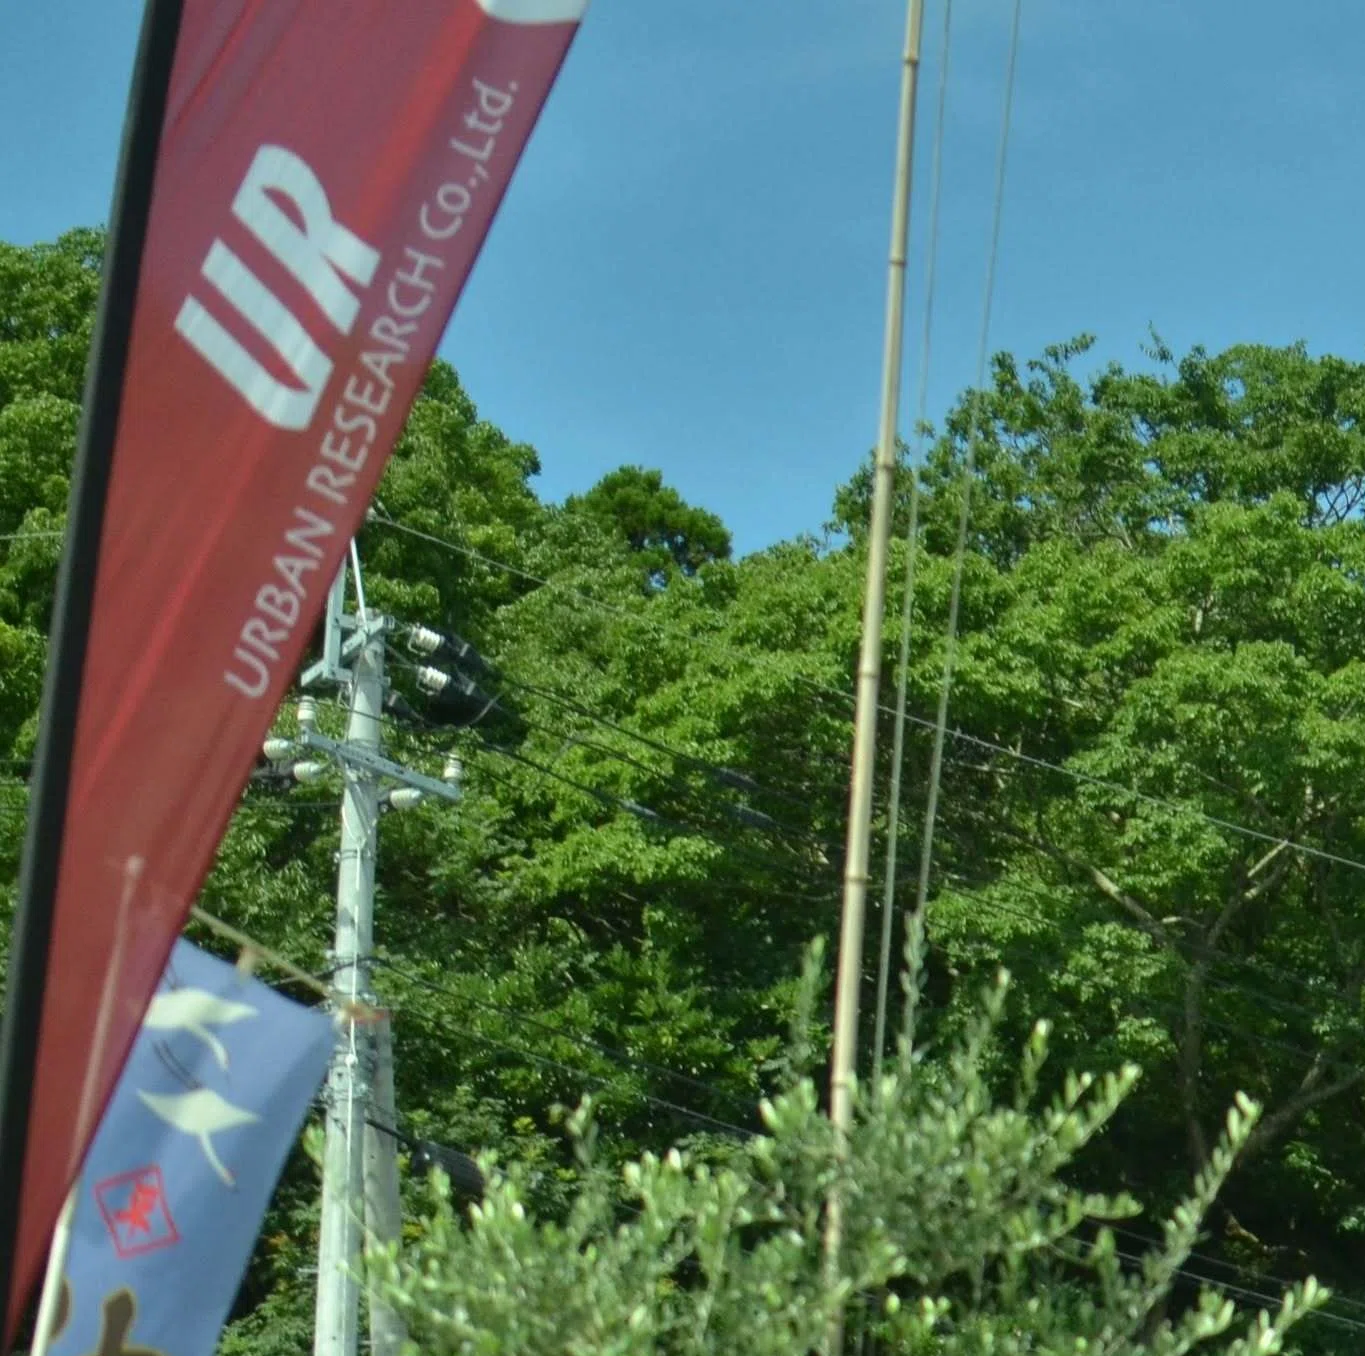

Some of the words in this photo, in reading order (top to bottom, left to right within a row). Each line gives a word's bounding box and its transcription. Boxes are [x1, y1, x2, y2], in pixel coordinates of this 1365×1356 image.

[174, 144, 381, 431] UR
[224, 514, 336, 700] URBAN
[308, 246, 446, 504] RESEARCH
